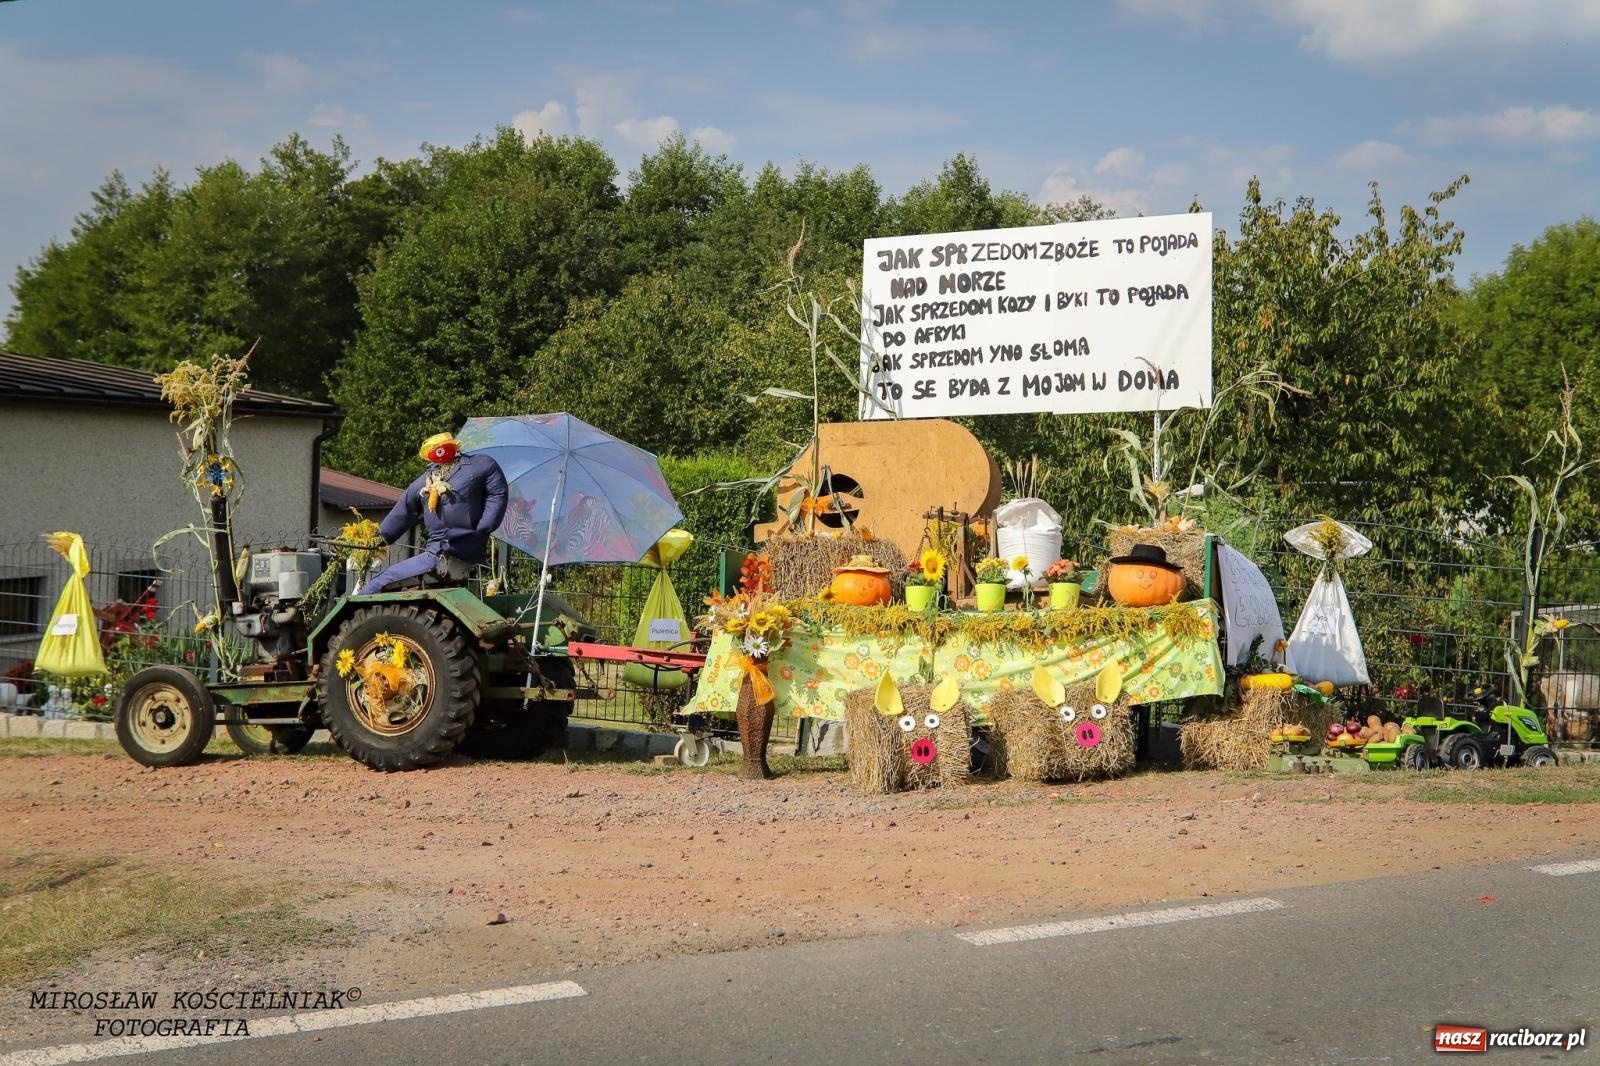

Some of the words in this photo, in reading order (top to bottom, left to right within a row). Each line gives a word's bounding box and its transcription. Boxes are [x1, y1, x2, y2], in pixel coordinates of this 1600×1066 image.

[877, 247, 922, 272] JAK
[1113, 238, 1135, 254] TO
[1139, 232, 1198, 256] POJADA
[890, 276, 928, 299] NAD
[938, 271, 1006, 294] MORZE
[873, 303, 905, 328] JAK
[910, 300, 993, 322] SPRZEDOM
[997, 294, 1036, 314] KOZY
[1044, 294, 1051, 312] I
[1057, 291, 1088, 310] BYKI
[1096, 288, 1120, 306] TO
[1127, 283, 1189, 307] POJADA
[882, 331, 906, 349] DO
[914, 324, 966, 345] AFRYKI
[909, 348, 984, 369] SPRZEDOM
[989, 344, 1023, 361] YNO
[1029, 336, 1090, 361] SŁOMA
[876, 381, 903, 401] TO
[911, 379, 938, 400] SE
[948, 378, 991, 399] BYDA
[997, 376, 1011, 396] Z
[1022, 372, 1086, 397] MOJOM
[1092, 372, 1106, 391] W
[1118, 369, 1181, 393] DOMA
